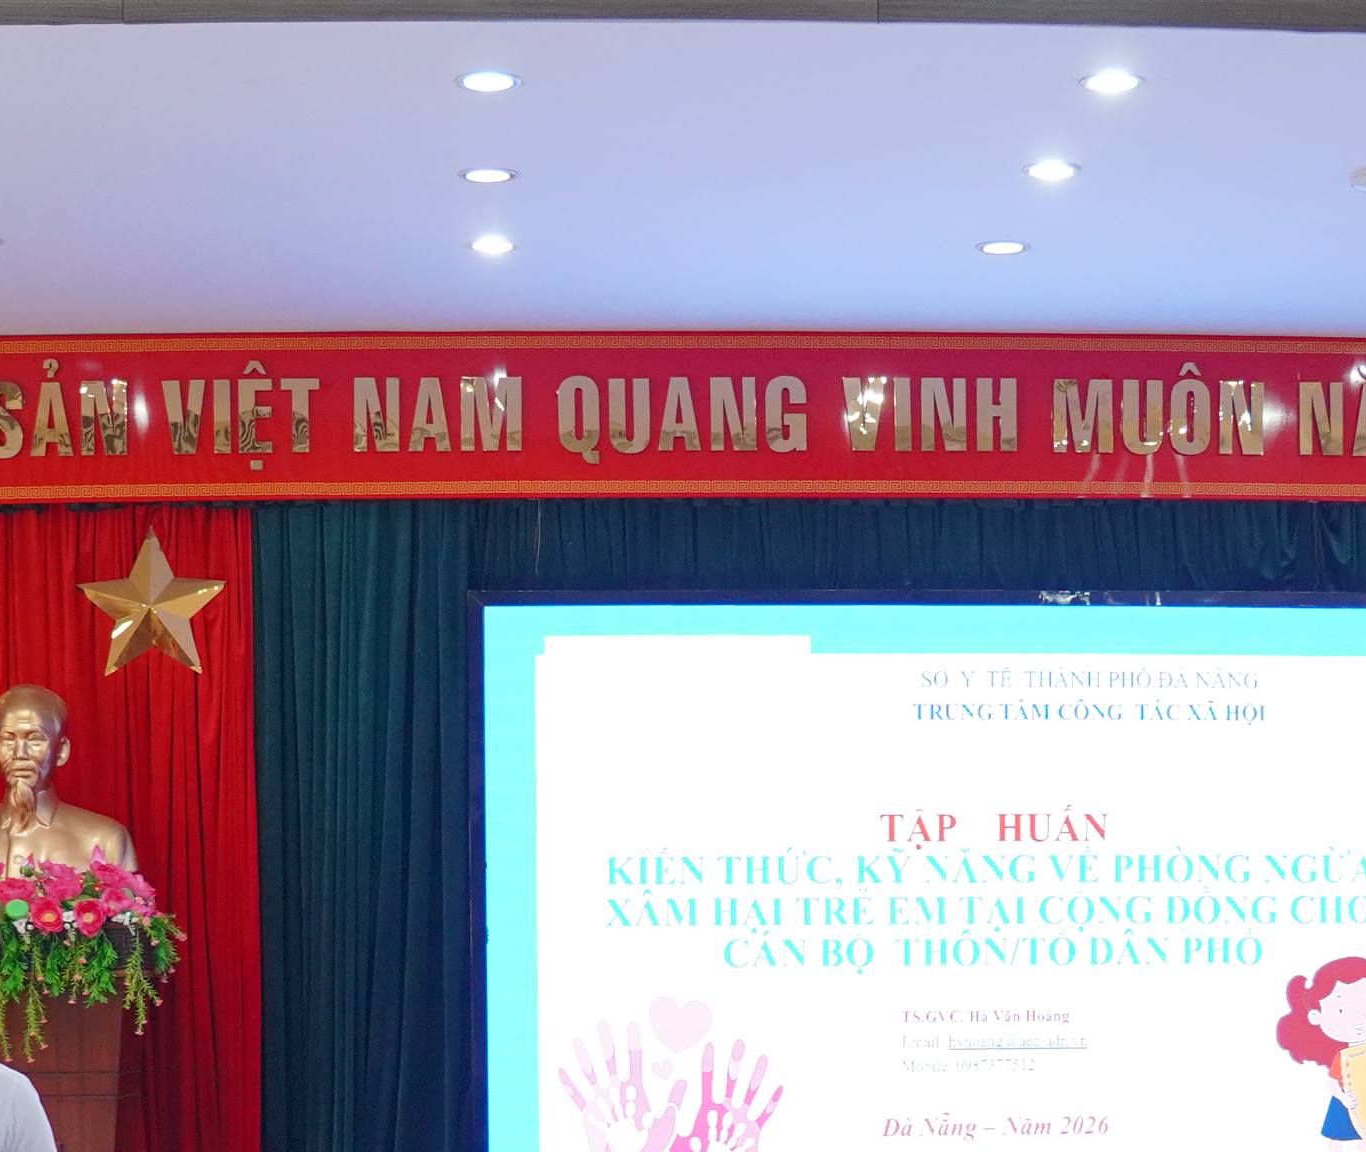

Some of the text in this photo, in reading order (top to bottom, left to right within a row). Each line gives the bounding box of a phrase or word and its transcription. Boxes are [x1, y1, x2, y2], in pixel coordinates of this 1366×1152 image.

[161, 360, 321, 471] VIỆT
[353, 376, 523, 453] NAM
[556, 375, 808, 464] QUANG
[843, 376, 1017, 454] VINH
[1053, 361, 1264, 457] MUÔN
[960, 670, 975, 688] Y
[987, 666, 1012, 688] TẾ
[1025, 666, 1100, 688] THÀNH
[1158, 666, 1188, 689] ĐÀ
[913, 699, 1264, 726] TRUNG TÂM CÔNG TÁC XÃ HỘI
[880, 804, 1107, 852] TẬP HUẤN
[608, 848, 704, 886] KIẾN
[717, 847, 843, 886] THỨC,
[856, 848, 910, 885] KỸ
[925, 848, 1035, 884] NĂNG
[1048, 846, 1099, 884] VỀ
[1114, 846, 1251, 884] PHÒNG
[607, 889, 698, 927] XÂM
[714, 896, 783, 935] HẠI
[796, 889, 874, 926] TRẺ
[888, 896, 946, 926] EM
[960, 896, 1025, 933] TẠI
[1039, 892, 1152, 933] CỘNG
[1166, 887, 1278, 924] ĐỒNG
[723, 930, 805, 968] CÁN
[821, 935, 875, 975] BỘ
[1089, 928, 1167, 966] DÂN
[1183, 929, 1263, 965] PHỐ
[1025, 1009, 1071, 1024] Hoàng
[882, 1117, 913, 1137] Đà
[920, 1111, 978, 1142] Nẵng
[1003, 1114, 1052, 1136] Năm
[1059, 1115, 1110, 1135] 2026
